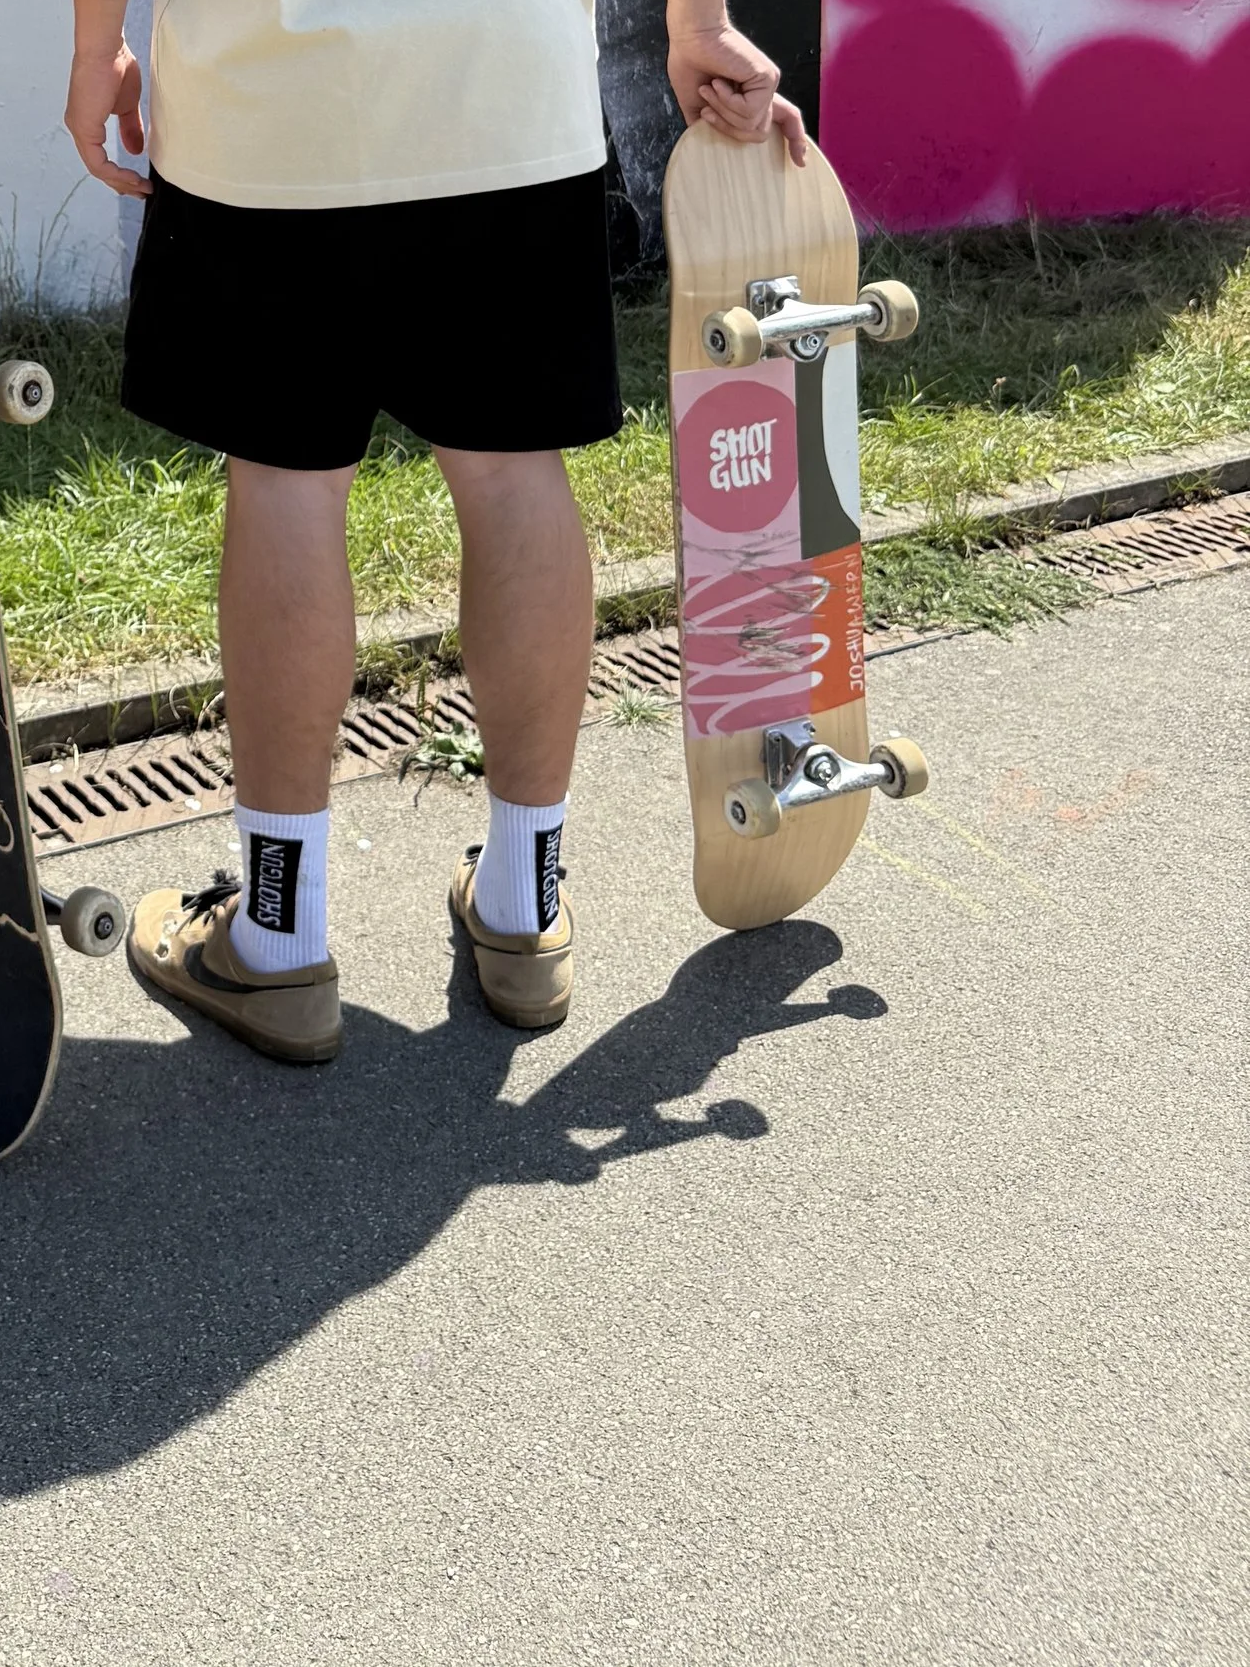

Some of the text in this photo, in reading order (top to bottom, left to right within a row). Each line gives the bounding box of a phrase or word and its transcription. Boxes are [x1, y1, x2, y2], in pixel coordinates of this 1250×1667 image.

[709, 417, 778, 462] SHOT
[709, 455, 772, 492] GUN
[256, 840, 286, 928] SHOTGUN
[542, 829, 561, 921] SHOTGUN
